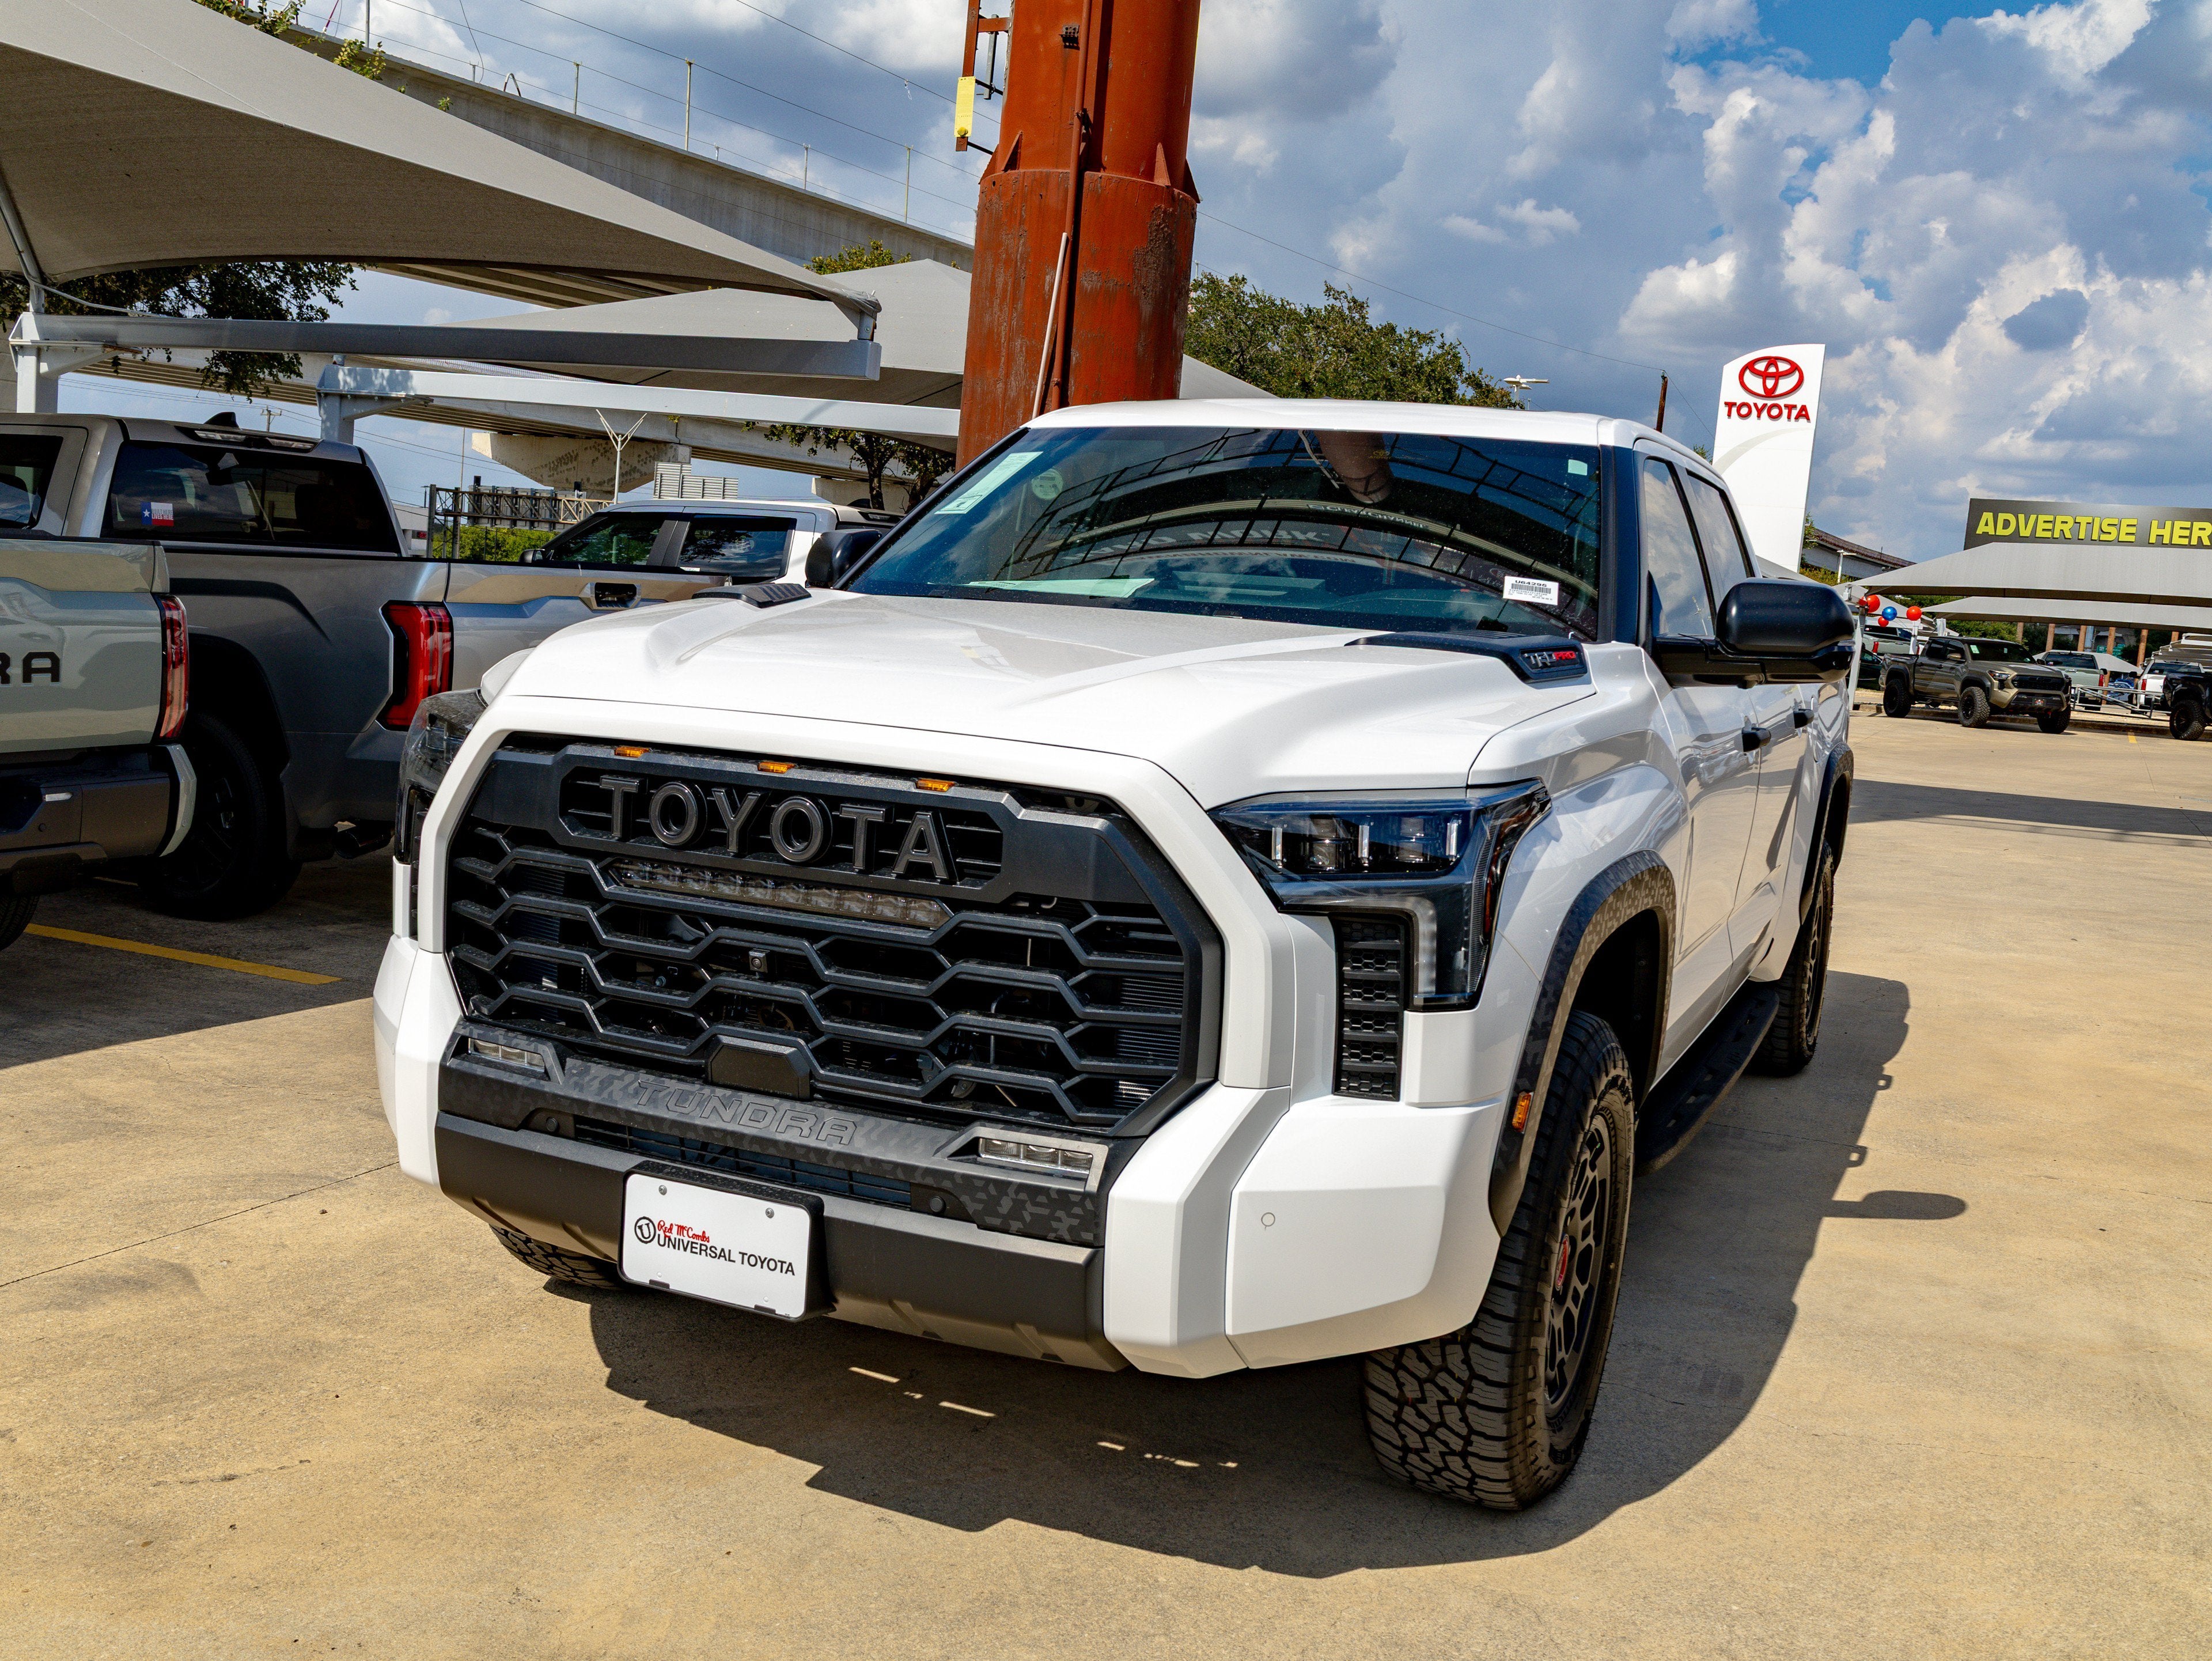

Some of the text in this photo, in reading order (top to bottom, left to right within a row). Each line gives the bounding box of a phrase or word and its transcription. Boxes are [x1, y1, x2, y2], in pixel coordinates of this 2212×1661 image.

[1724, 402, 1810, 421] TOYOTA
[1976, 512, 2212, 546] ADVERTISE HER
[1524, 650, 1577, 667] TRD PRO
[599, 775, 956, 883] TOYOTA
[637, 1080, 857, 1145] TUNDRA
[657, 1220, 710, 1243] Red McCombs
[657, 1234, 796, 1276] UNIVERSAL TOYOTA
